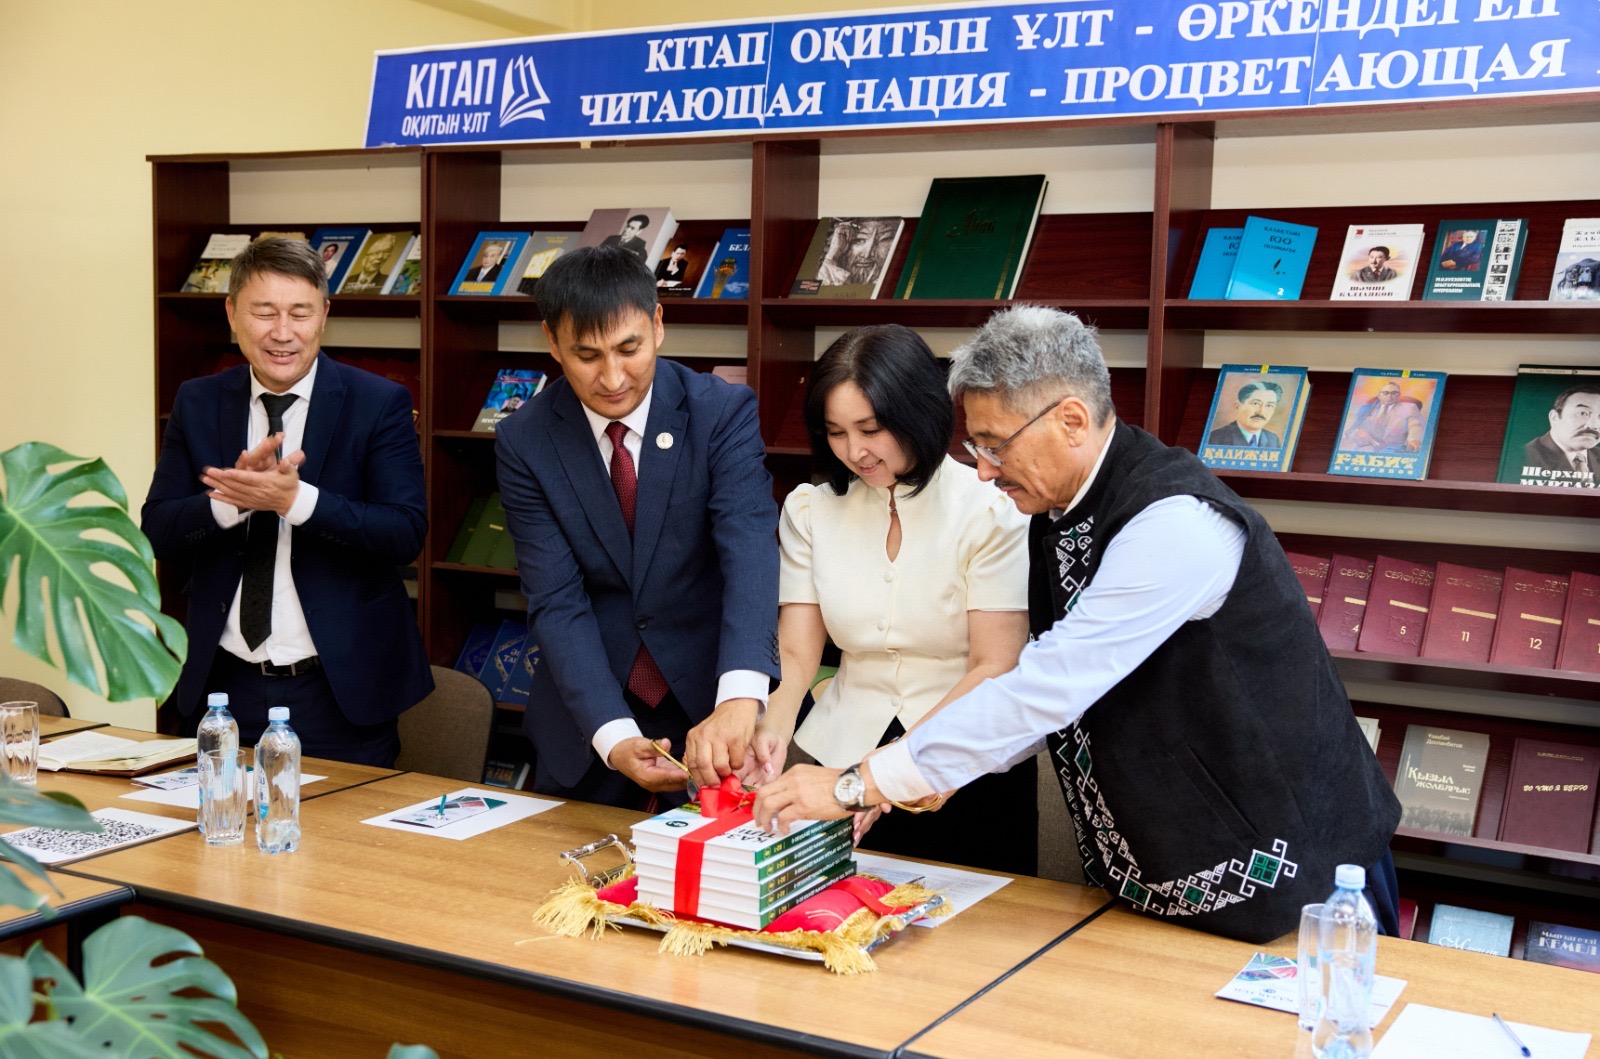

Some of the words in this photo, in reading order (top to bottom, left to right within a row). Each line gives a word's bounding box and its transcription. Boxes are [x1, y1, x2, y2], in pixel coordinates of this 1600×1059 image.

[645, 31, 769, 73] КІТАП
[790, 16, 990, 68] ОҚИТЫН
[1016, 9, 1113, 51] ҰЛТ
[406, 58, 497, 109] КІТАП
[580, 81, 825, 129] ЧИТАЮЩАЯ
[844, 72, 1010, 118] НАЦИЯ
[1061, 38, 1571, 107] ПРОЦВЕТАЮЩАЯ
[401, 113, 459, 137] ОҚИТЫН
[463, 111, 490, 133] ҰЛТ
[1276, 288, 1285, 296] 2
[1521, 465, 1594, 481] Шерхан
[1352, 624, 1359, 633] 4
[1400, 626, 1406, 635] 5
[1461, 631, 1470, 642] 11
[1529, 637, 1543, 650] 12
